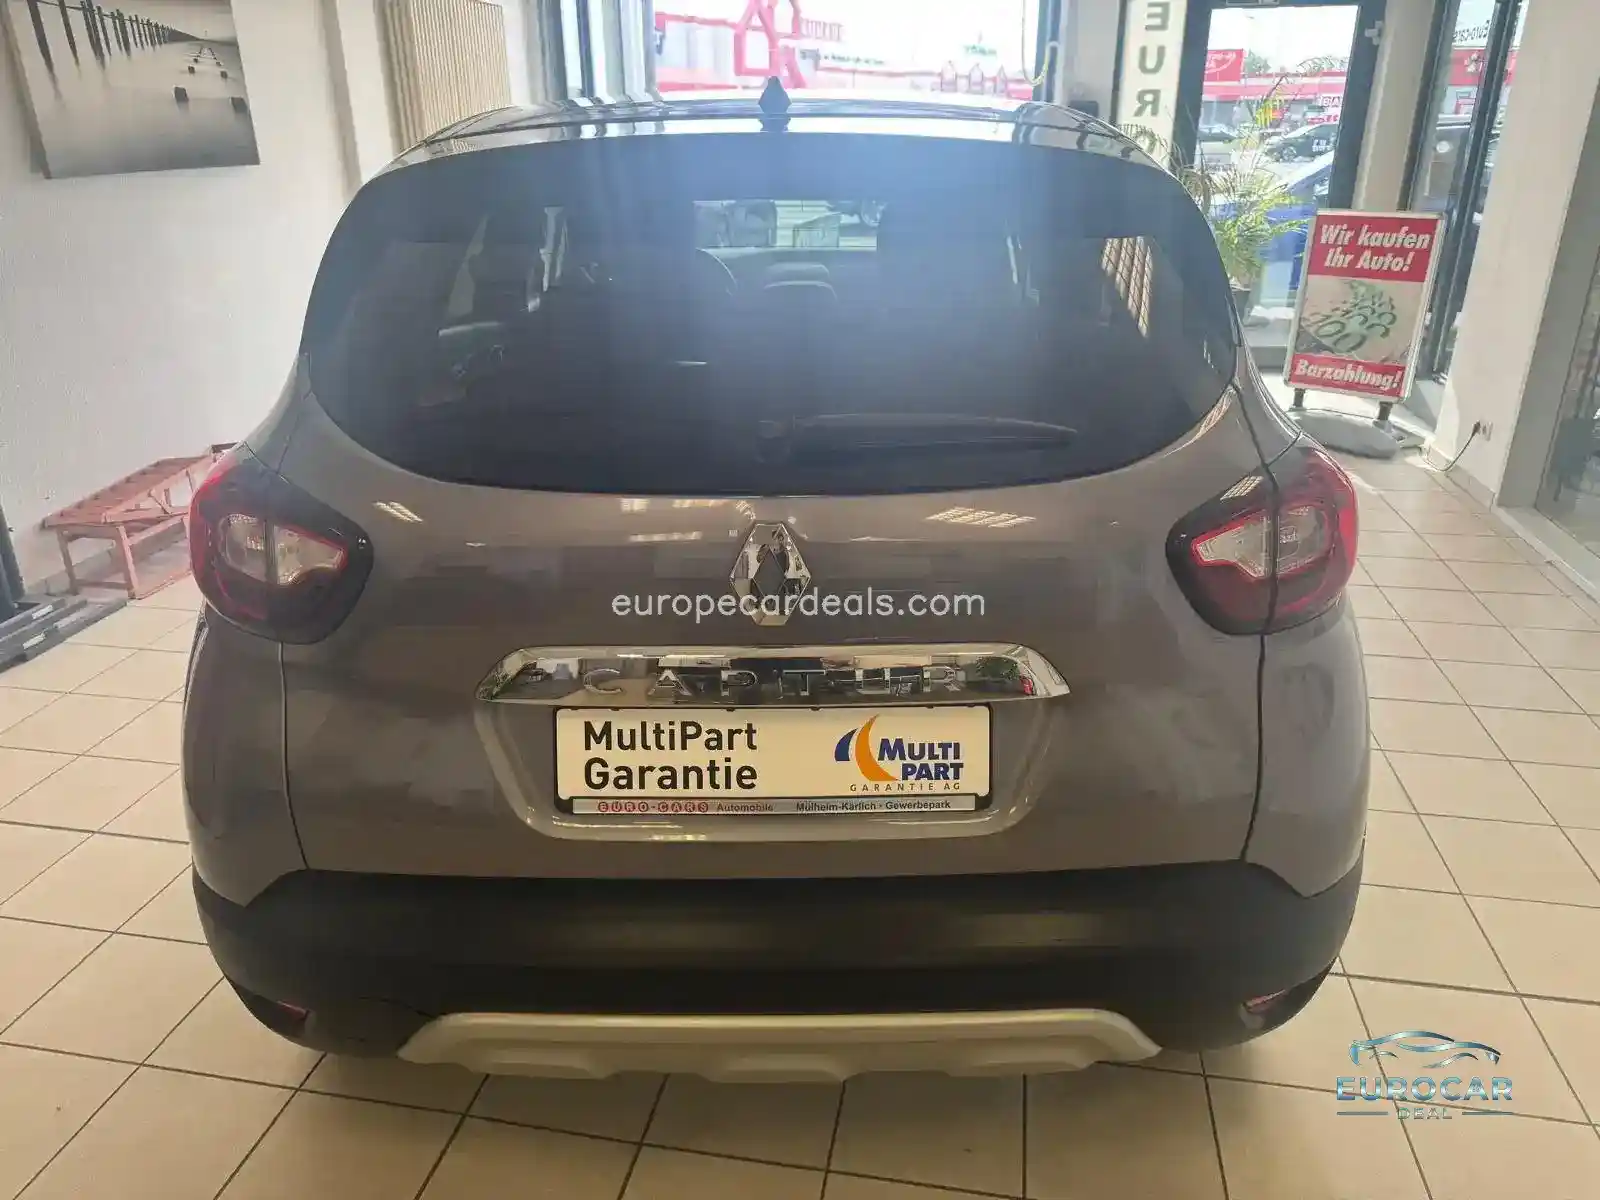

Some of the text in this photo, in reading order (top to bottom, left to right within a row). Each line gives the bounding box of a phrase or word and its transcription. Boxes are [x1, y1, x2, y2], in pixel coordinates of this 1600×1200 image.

[1320, 223, 1432, 249] Wir kaufen
[1324, 246, 1415, 272] Ihr Auto!
[1294, 358, 1402, 390] Barzahlung!
[583, 667, 963, 697] CAPTUR
[584, 721, 758, 751] MultiPart
[877, 738, 961, 761] MULTI
[584, 757, 758, 790] Garantie
[901, 763, 964, 781] PART
[850, 782, 961, 792] GARANTIE AG
[716, 802, 775, 812] Automobile
[885, 799, 951, 811] Gewerbepark
